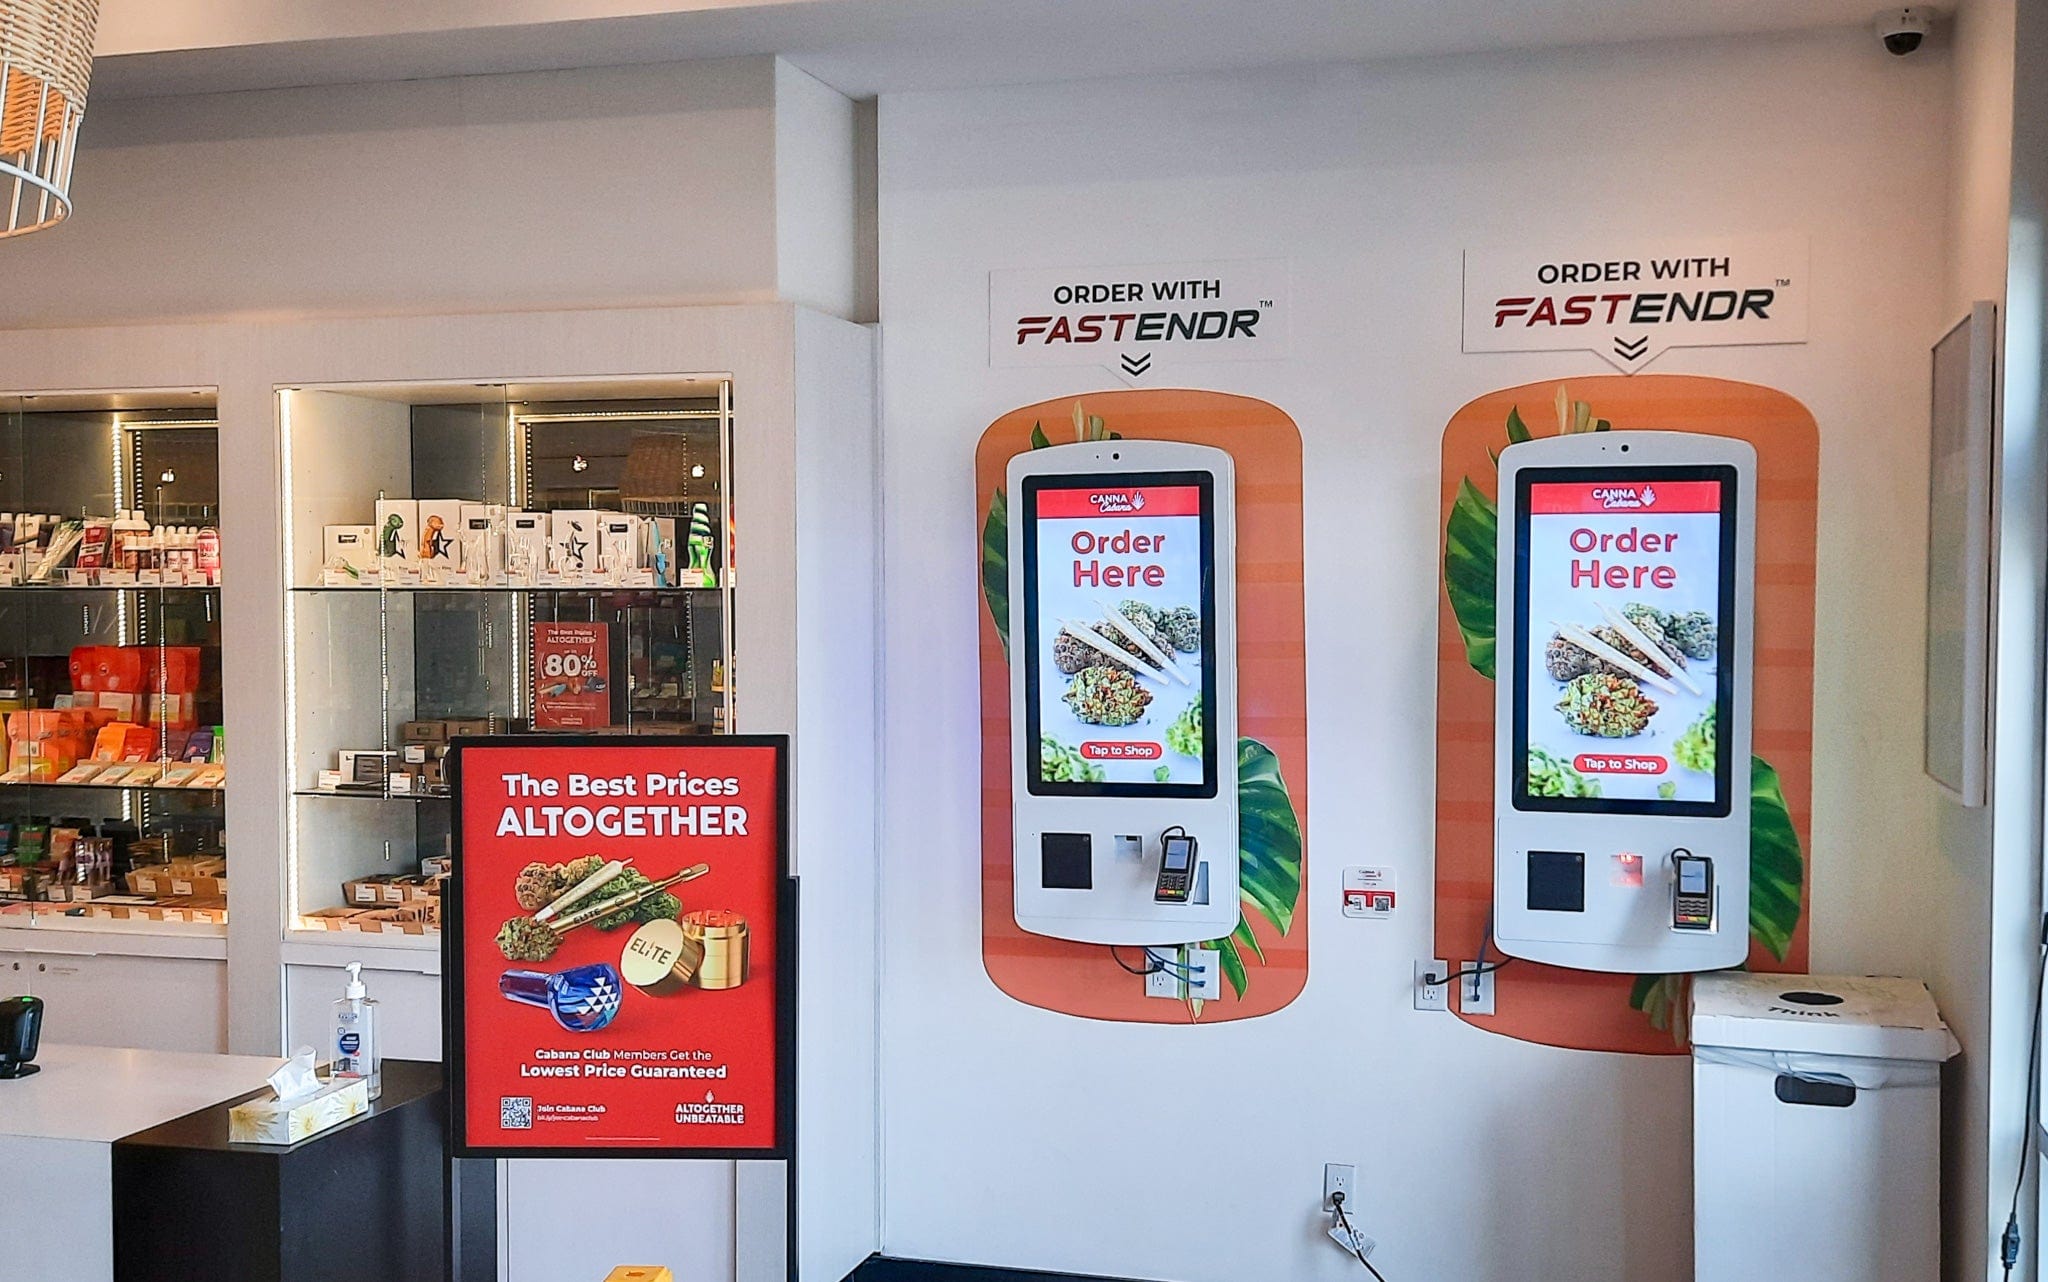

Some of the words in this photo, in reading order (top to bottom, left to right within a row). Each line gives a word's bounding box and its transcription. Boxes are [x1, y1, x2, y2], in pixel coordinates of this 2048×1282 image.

[1537, 260, 1641, 285] ORDER
[1650, 257, 1730, 280] WITH
[1053, 282, 1144, 304] ORDER
[1151, 279, 1221, 302] WITH
[1495, 289, 1775, 328] FASTENDR
[1017, 308, 1260, 345] FASTENDR
[1090, 494, 1128, 503] CANNA
[1592, 489, 1637, 499] CANNA
[1071, 529, 1165, 555] Order
[1569, 526, 1679, 554] Order
[1072, 560, 1165, 588] Here
[1570, 559, 1677, 590] Here
[545, 653, 597, 677] 80%
[1089, 745, 1109, 759] Tap
[1111, 745, 1122, 757] to
[1124, 745, 1153, 759] Shop
[1583, 757, 1606, 772] Tap
[1608, 758, 1622, 771] to
[1624, 757, 1658, 773] Shop
[502, 773, 559, 797] The
[567, 774, 637, 797] Best
[646, 772, 739, 797] Prices
[496, 806, 748, 837] ALTOGETHER
[1768, 1006, 1841, 1017] Think
[535, 1049, 581, 1061] Cabana
[583, 1049, 611, 1061] Club
[613, 1049, 668, 1061] Members
[669, 1050, 690, 1061] Get
[692, 1050, 712, 1061] the
[520, 1064, 580, 1078] Lowest
[584, 1064, 627, 1078] Price
[630, 1065, 727, 1079] Guaranteed
[537, 1104, 555, 1113] Join
[555, 1104, 586, 1113] Cabana
[587, 1105, 606, 1113] Club
[675, 1103, 745, 1114] ALTOGETHER
[675, 1113, 746, 1124] UNBEATABLE
